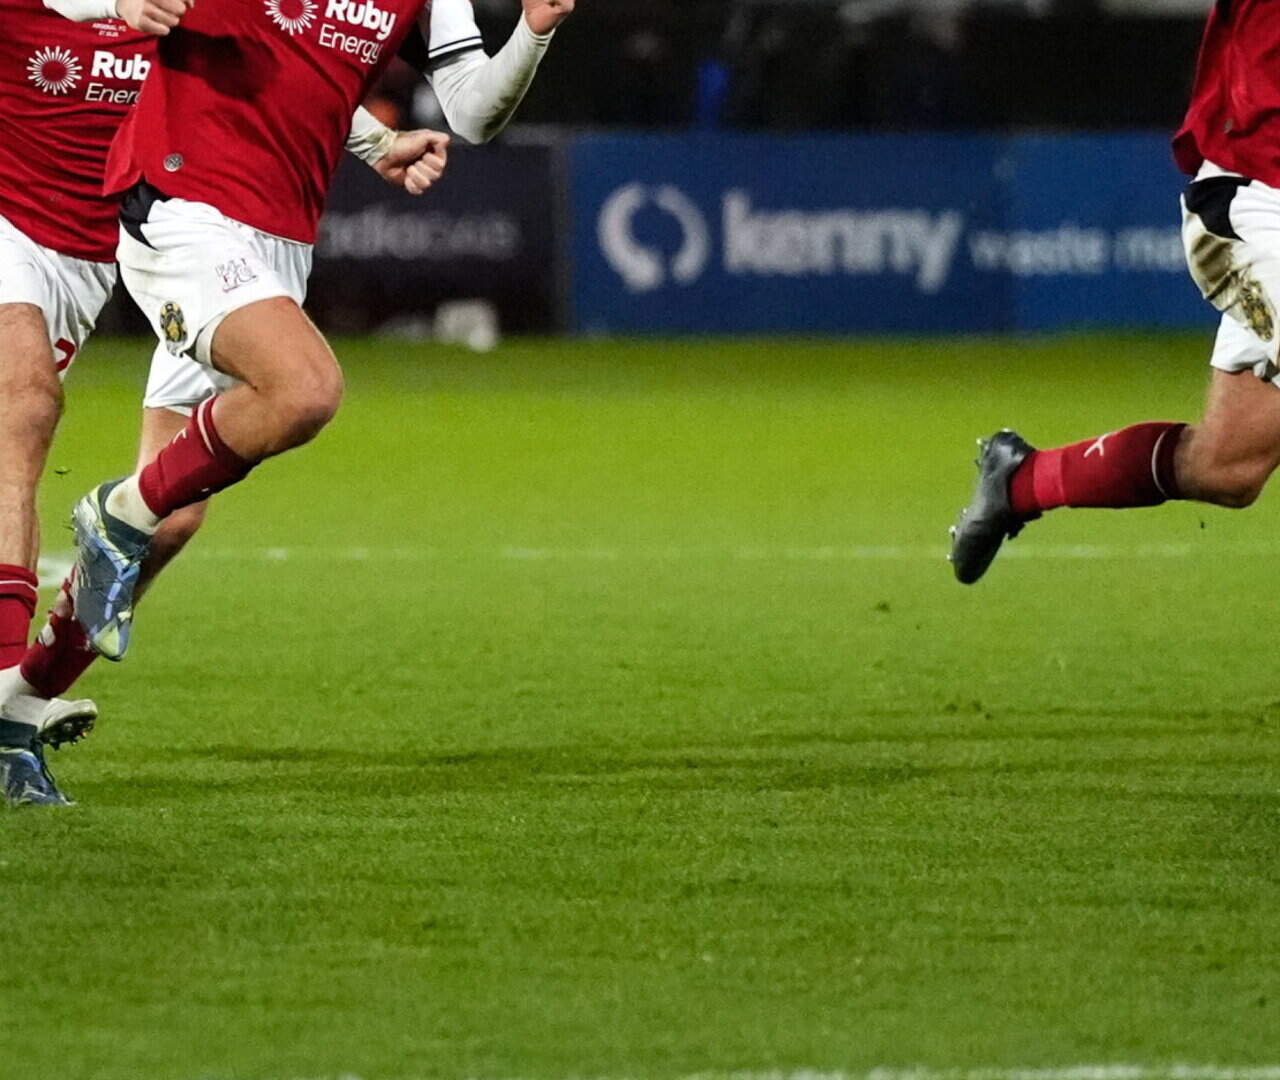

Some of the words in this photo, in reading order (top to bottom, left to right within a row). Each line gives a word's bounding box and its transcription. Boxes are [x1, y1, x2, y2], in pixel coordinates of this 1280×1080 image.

[318, 23, 384, 65] Energy
[91, 50, 152, 81] Rub
[723, 188, 963, 295] kenny
[970, 226, 1108, 275] waste
